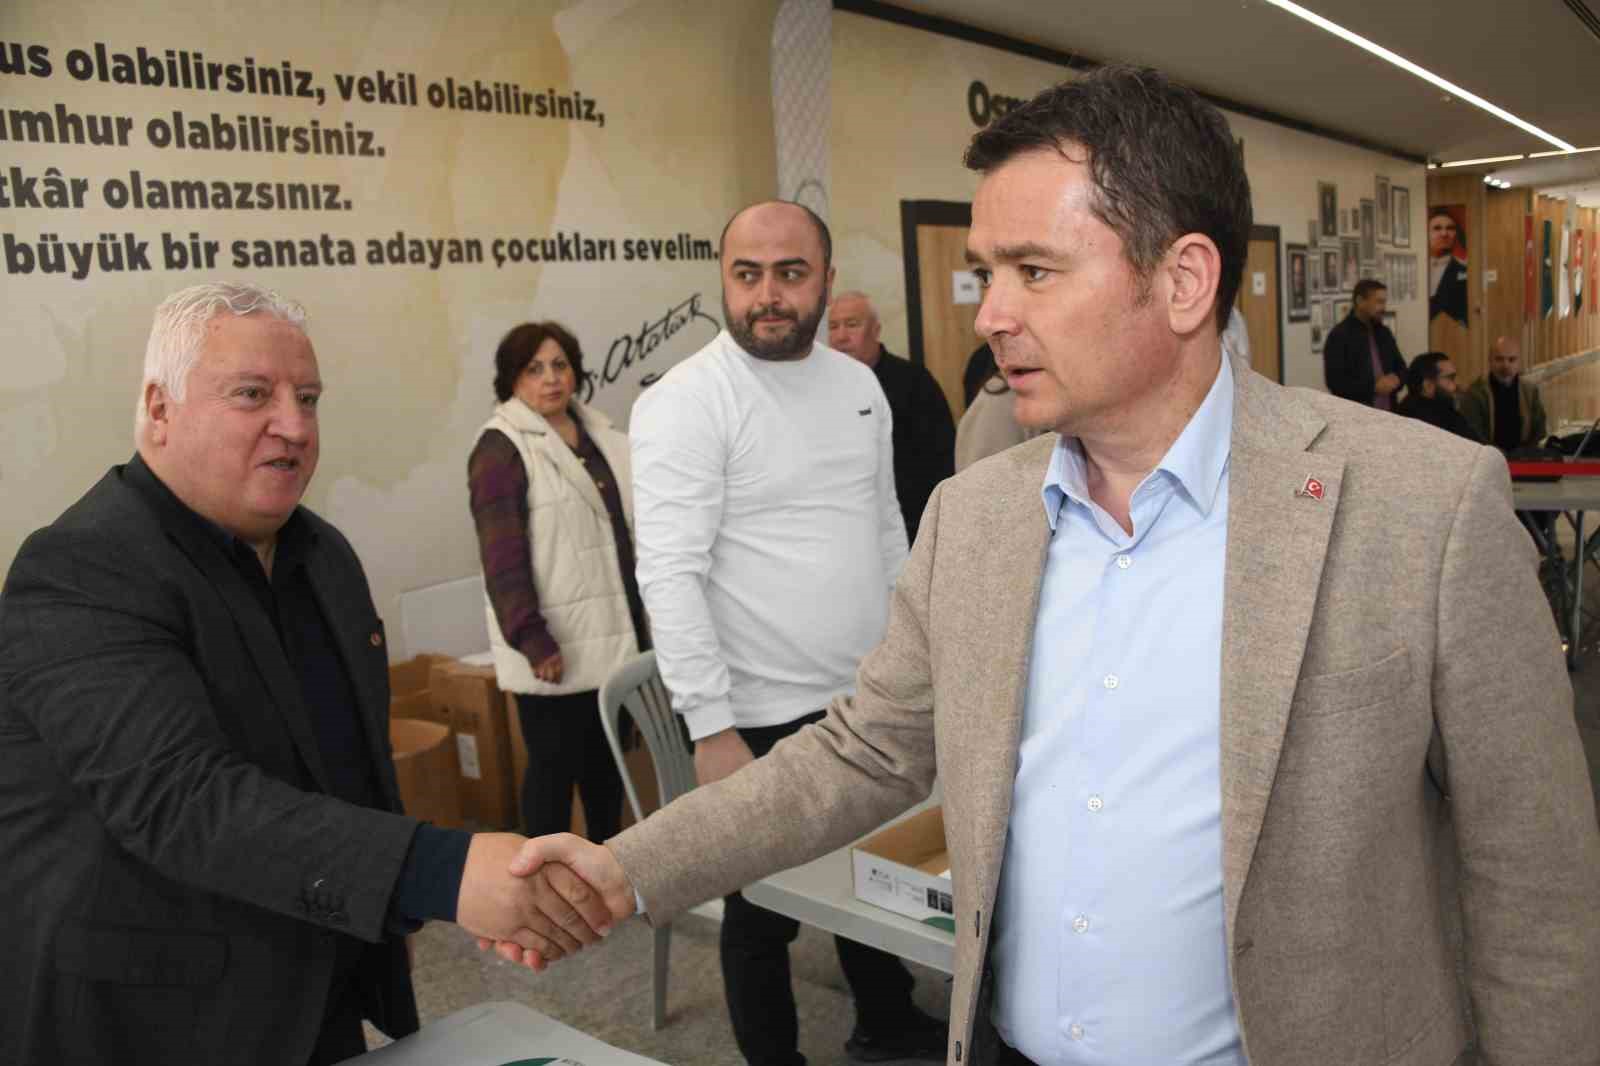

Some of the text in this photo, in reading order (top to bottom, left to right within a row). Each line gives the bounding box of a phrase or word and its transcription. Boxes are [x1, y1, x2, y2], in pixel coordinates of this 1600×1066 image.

[65, 42, 326, 105] olabilirsiniz,
[333, 69, 418, 107] vekil
[426, 77, 605, 128] olabilirsiniz,
[146, 110, 386, 157] olabilirsiniz.
[102, 170, 353, 211] olamazsınız.
[2, 231, 720, 281] büyük bir sanata adayan çocukları sevelim.
